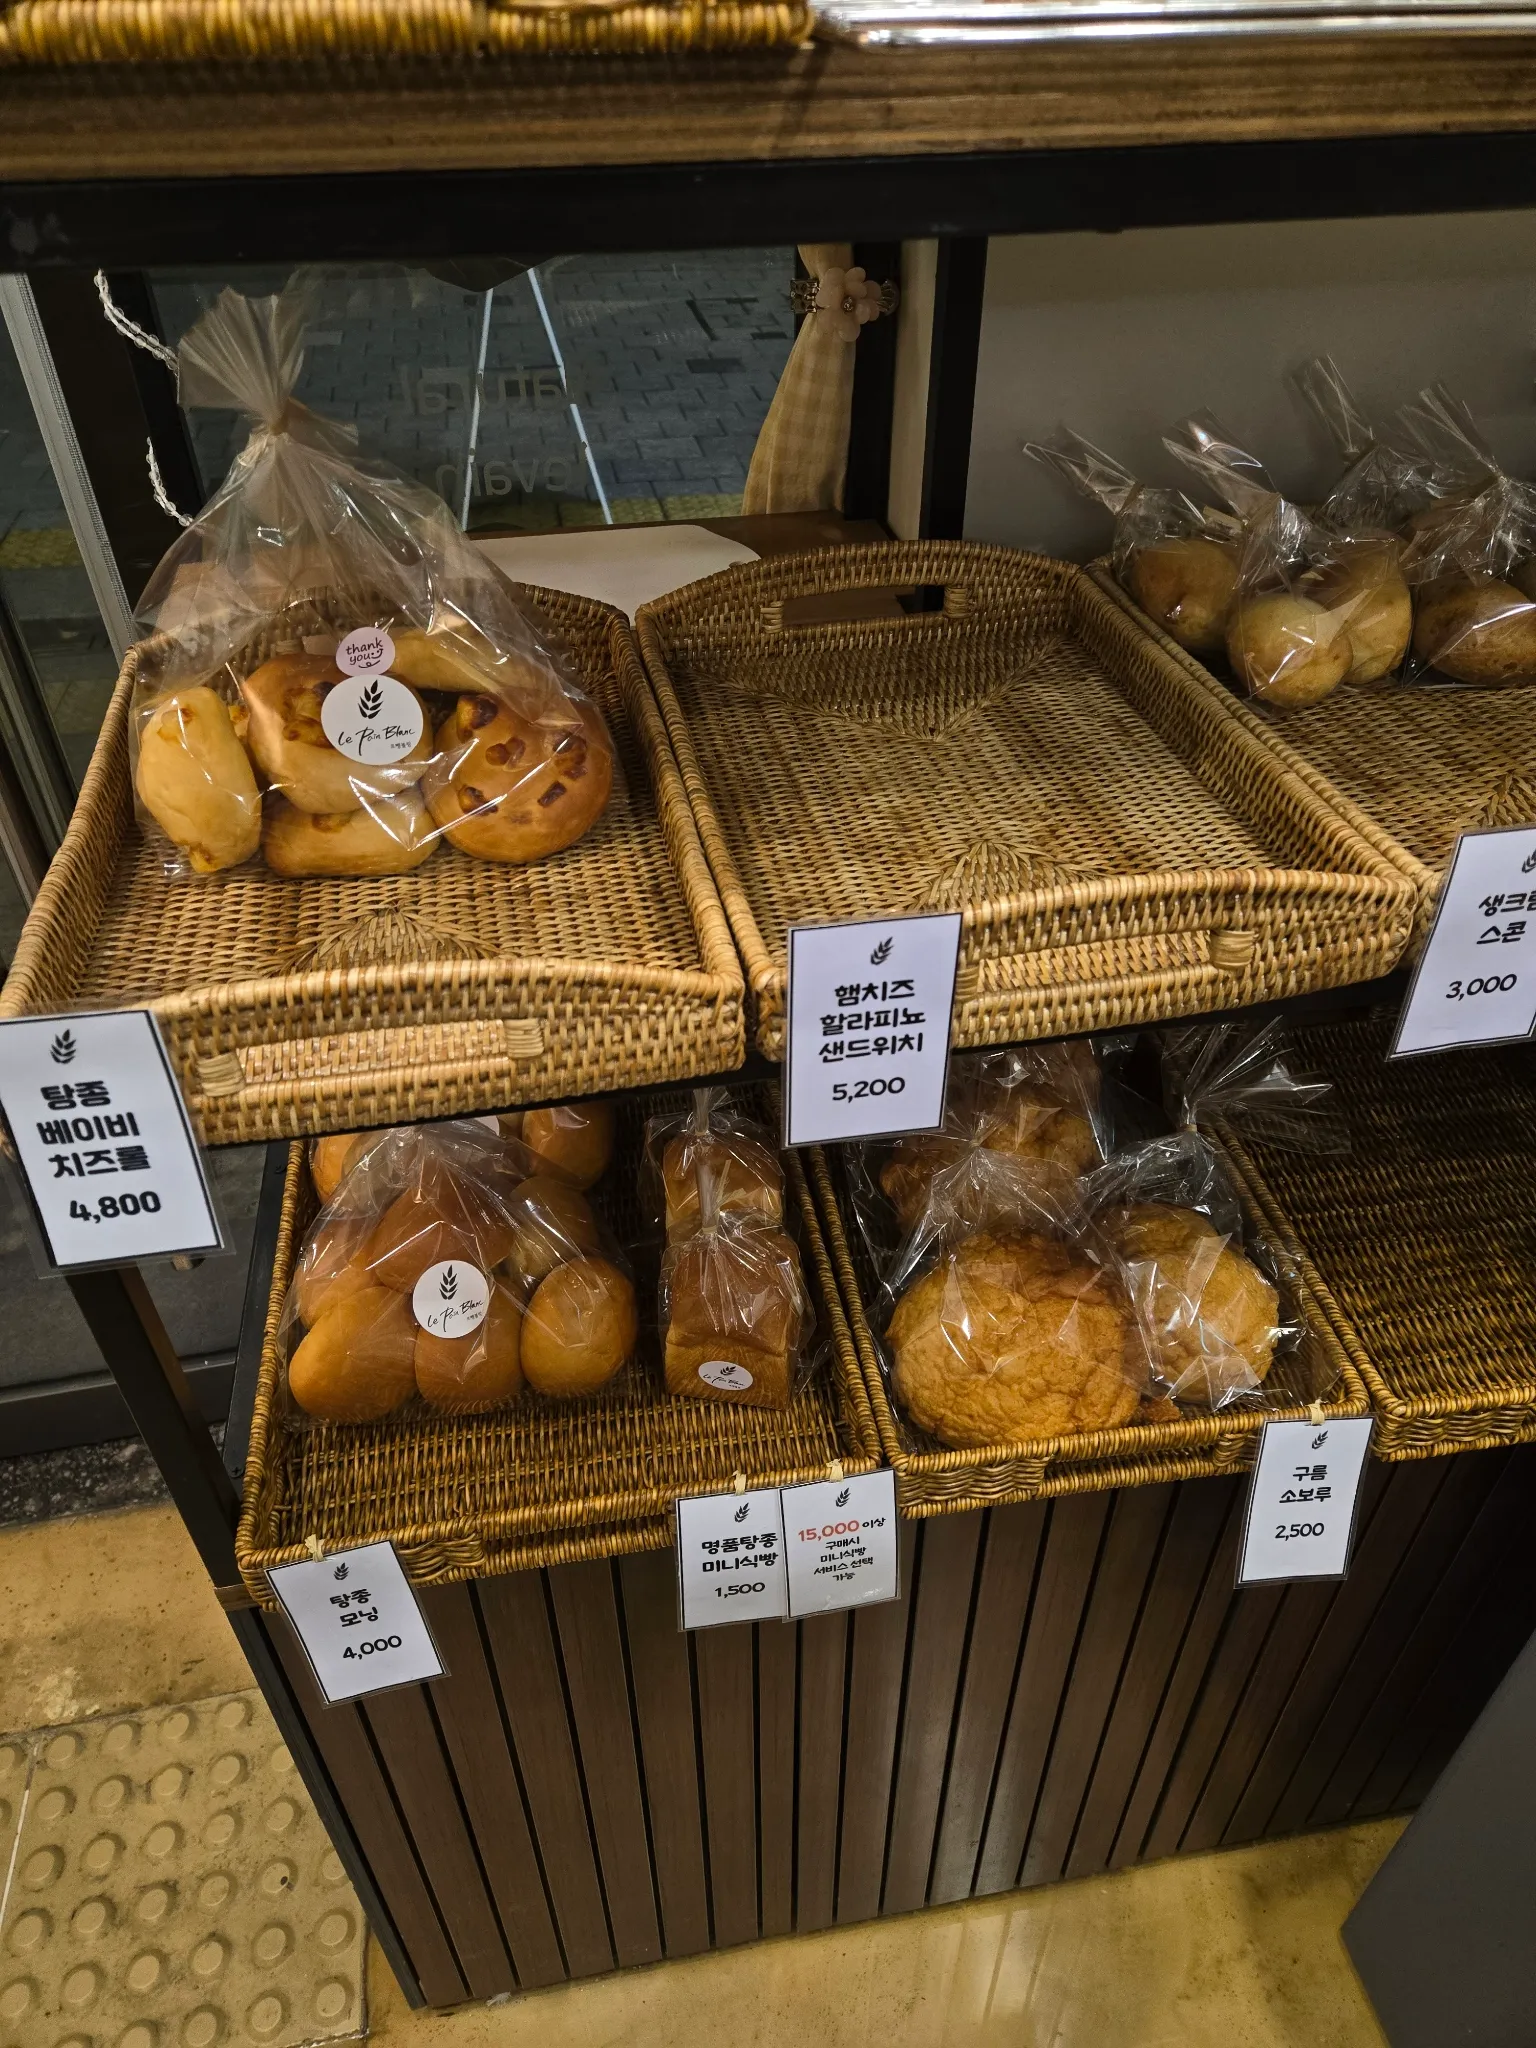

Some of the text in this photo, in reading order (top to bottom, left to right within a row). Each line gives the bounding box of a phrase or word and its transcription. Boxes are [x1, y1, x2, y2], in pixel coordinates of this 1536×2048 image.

[345, 637, 383, 655] thank
[350, 653, 371, 666] you
[338, 731, 353, 746] Le
[382, 724, 416, 740] Blanc
[1477, 921, 1526, 944] 스콘
[834, 979, 915, 1007] 햄치즈
[1446, 974, 1517, 1001] 3,000
[819, 1007, 926, 1037] 할라피뇨
[818, 1032, 923, 1064] 샌드위치
[40, 1080, 111, 1111] 탕종
[833, 1077, 905, 1103] 5,200
[36, 1112, 140, 1145] 베이비
[48, 1145, 151, 1178] 치즈롤
[70, 1191, 161, 1223] 4,800
[1293, 1465, 1327, 1481] 구름
[1279, 1487, 1331, 1503] 소보루
[798, 1518, 886, 1543] 15,000 이상
[1275, 1523, 1324, 1541] 2,500
[701, 1533, 778, 1555] 명품탕종
[825, 1536, 860, 1550] 구매시
[702, 1552, 779, 1573] 미니식빵
[813, 1557, 874, 1575] 서비스 선택
[820, 1547, 867, 1563] 미니식빵
[832, 1573, 856, 1581] 가능
[329, 1588, 372, 1609] 탕종
[715, 1582, 765, 1598] 1,500
[339, 1606, 379, 1628] 모닝
[343, 1636, 402, 1660] 4,000
